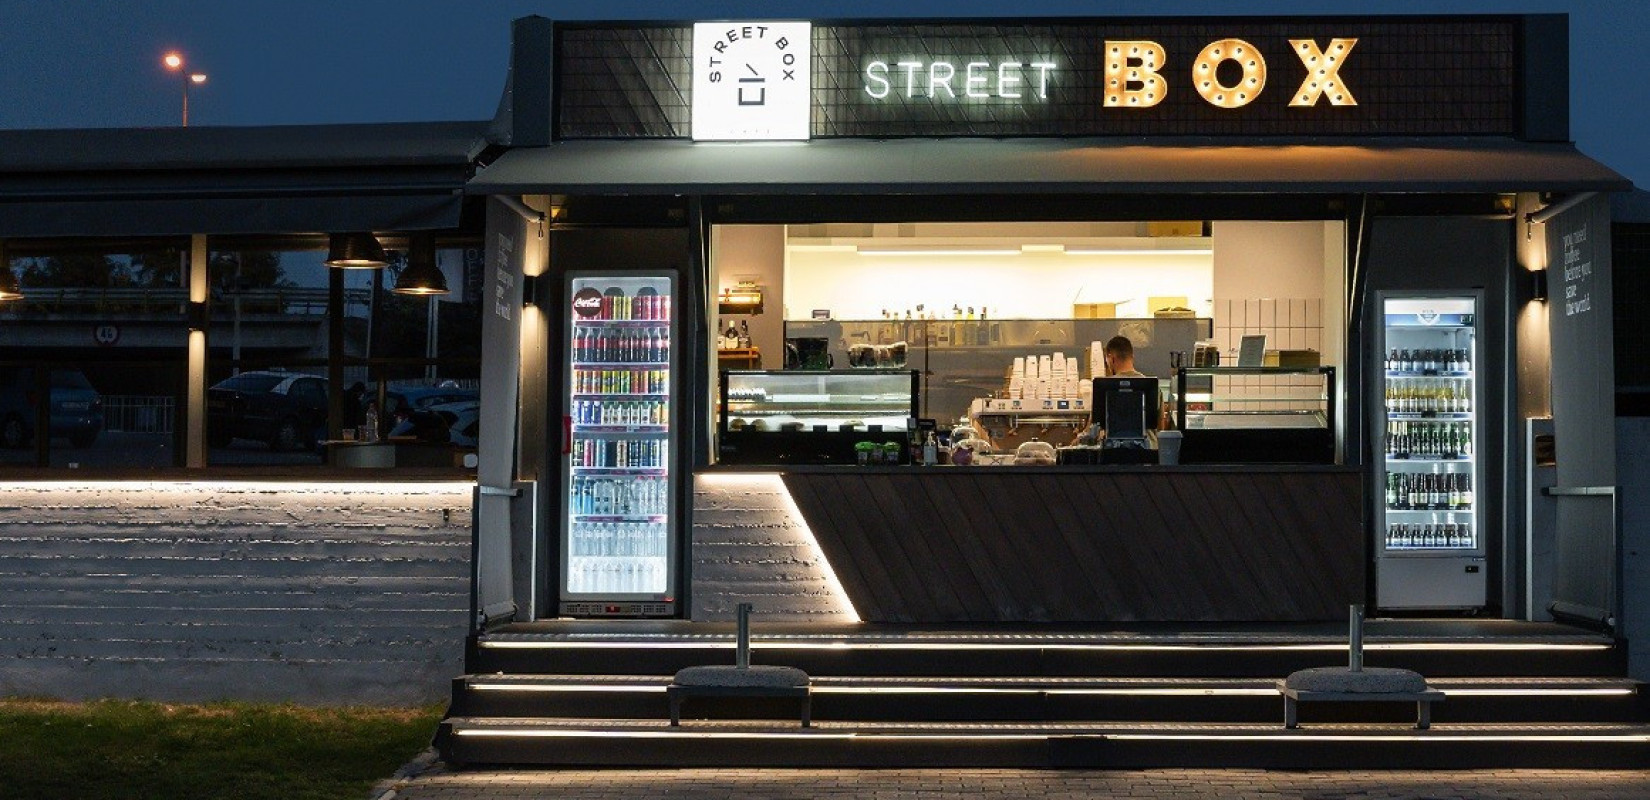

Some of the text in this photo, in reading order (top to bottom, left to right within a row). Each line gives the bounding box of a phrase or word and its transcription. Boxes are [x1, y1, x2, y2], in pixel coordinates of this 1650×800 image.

[709, 26, 796, 83] STREET BOX
[864, 38, 1358, 108] STREET BOX
